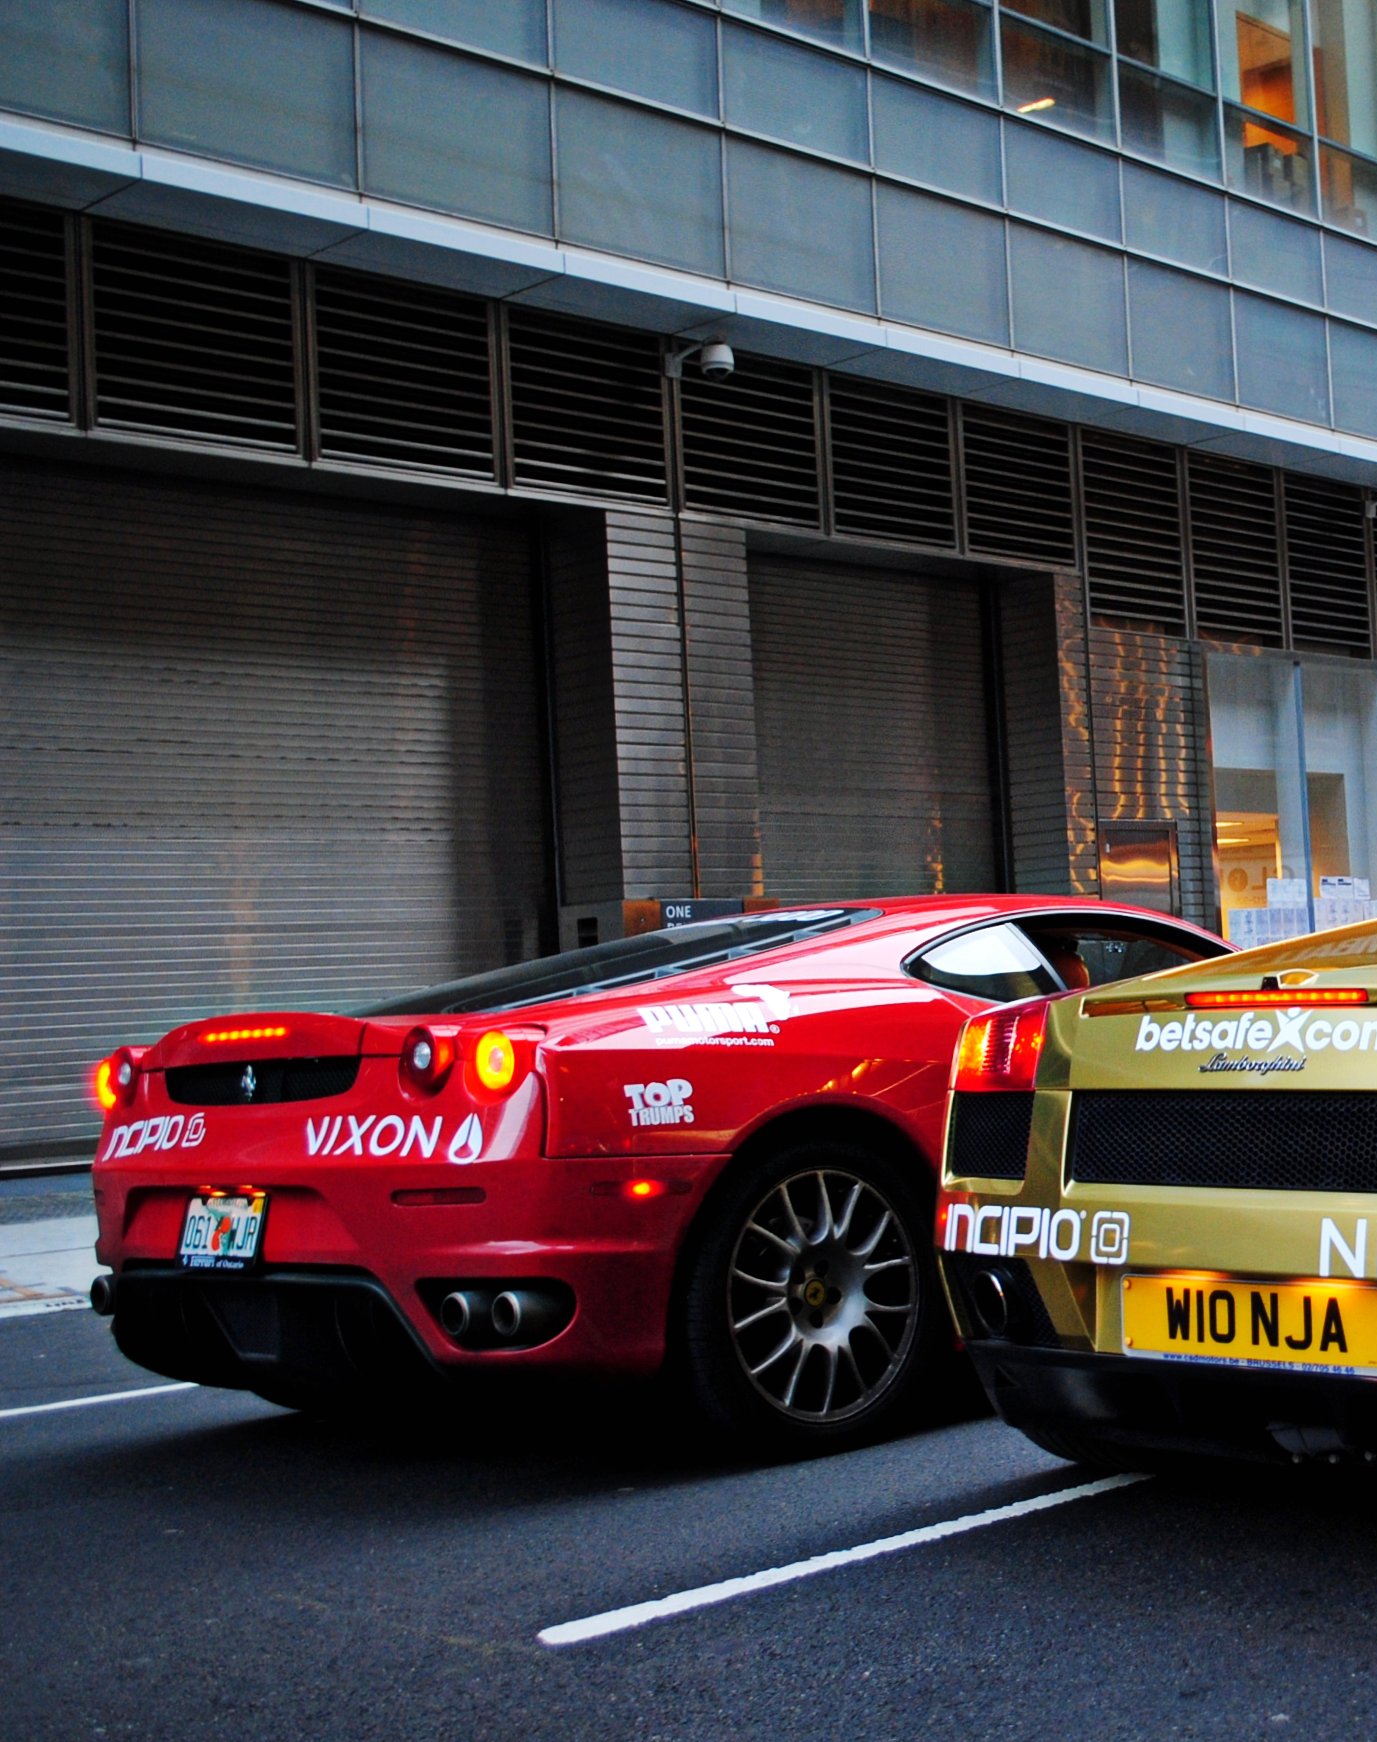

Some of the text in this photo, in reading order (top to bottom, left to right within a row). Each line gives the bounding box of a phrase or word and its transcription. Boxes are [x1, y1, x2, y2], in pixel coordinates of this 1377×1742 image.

[666, 905, 692, 919] ONE
[636, 1002, 770, 1034] PUMA
[1199, 1053, 1307, 1076] Lamborghini
[624, 1078, 693, 1110] TOP
[628, 1105, 695, 1127] TRUMPS
[944, 1203, 1082, 1262] INCIPIO
[1250, 1290, 1348, 1353] NJA
